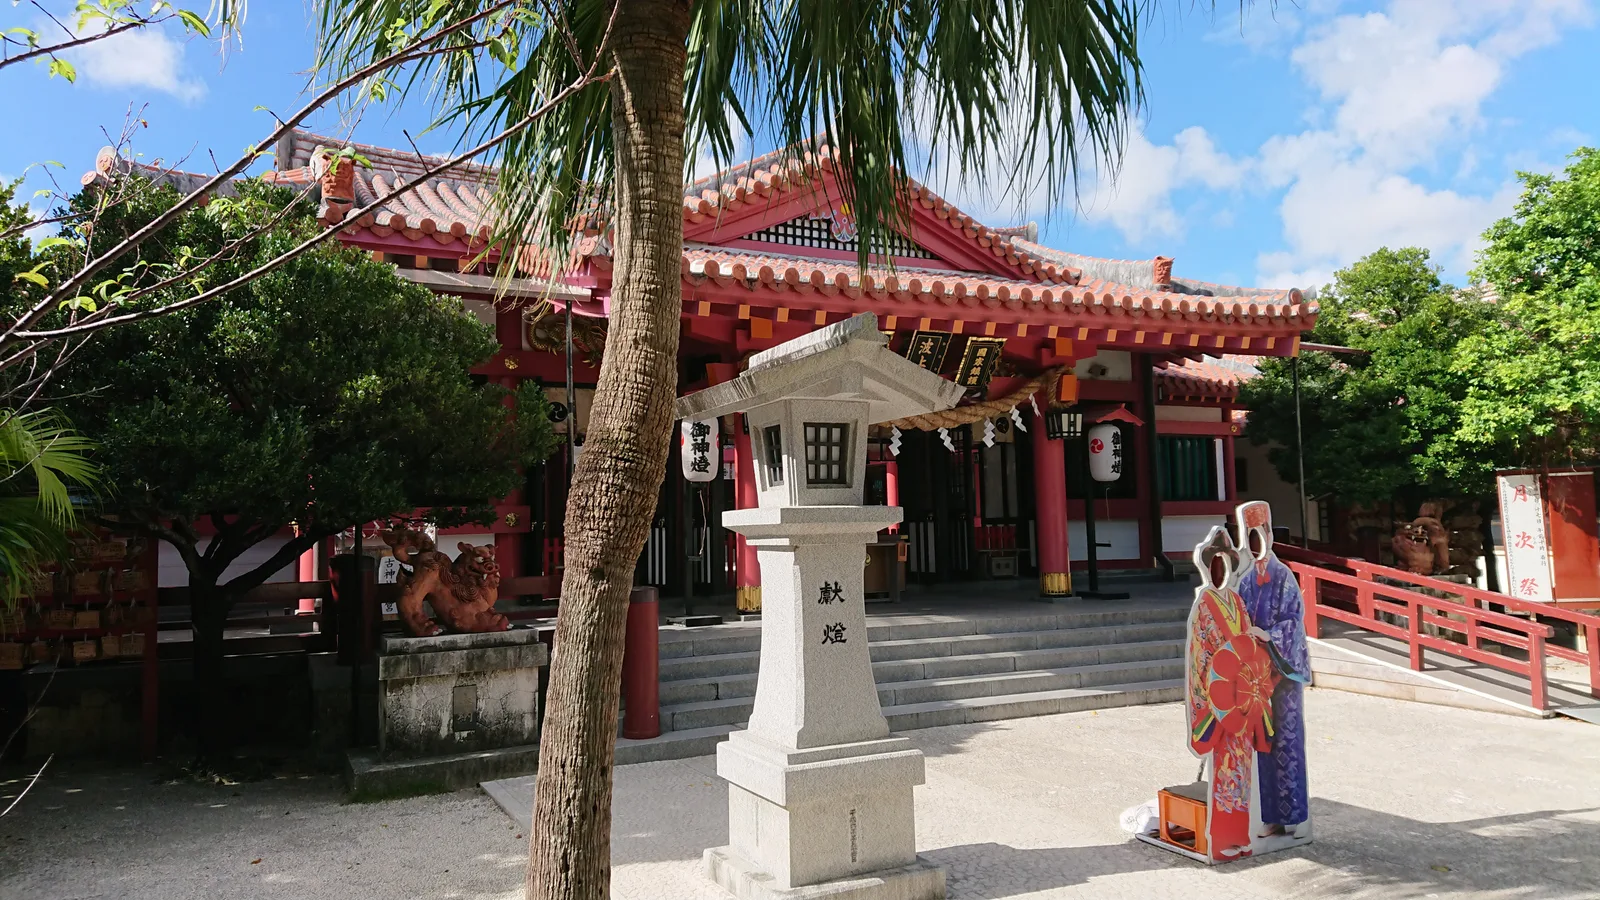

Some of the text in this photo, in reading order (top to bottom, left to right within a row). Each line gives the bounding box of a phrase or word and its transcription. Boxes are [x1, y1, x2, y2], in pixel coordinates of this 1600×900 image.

[690, 421, 711, 473] 御神燈
[1512, 484, 1539, 596] 月次祭
[384, 558, 396, 584] 古神
